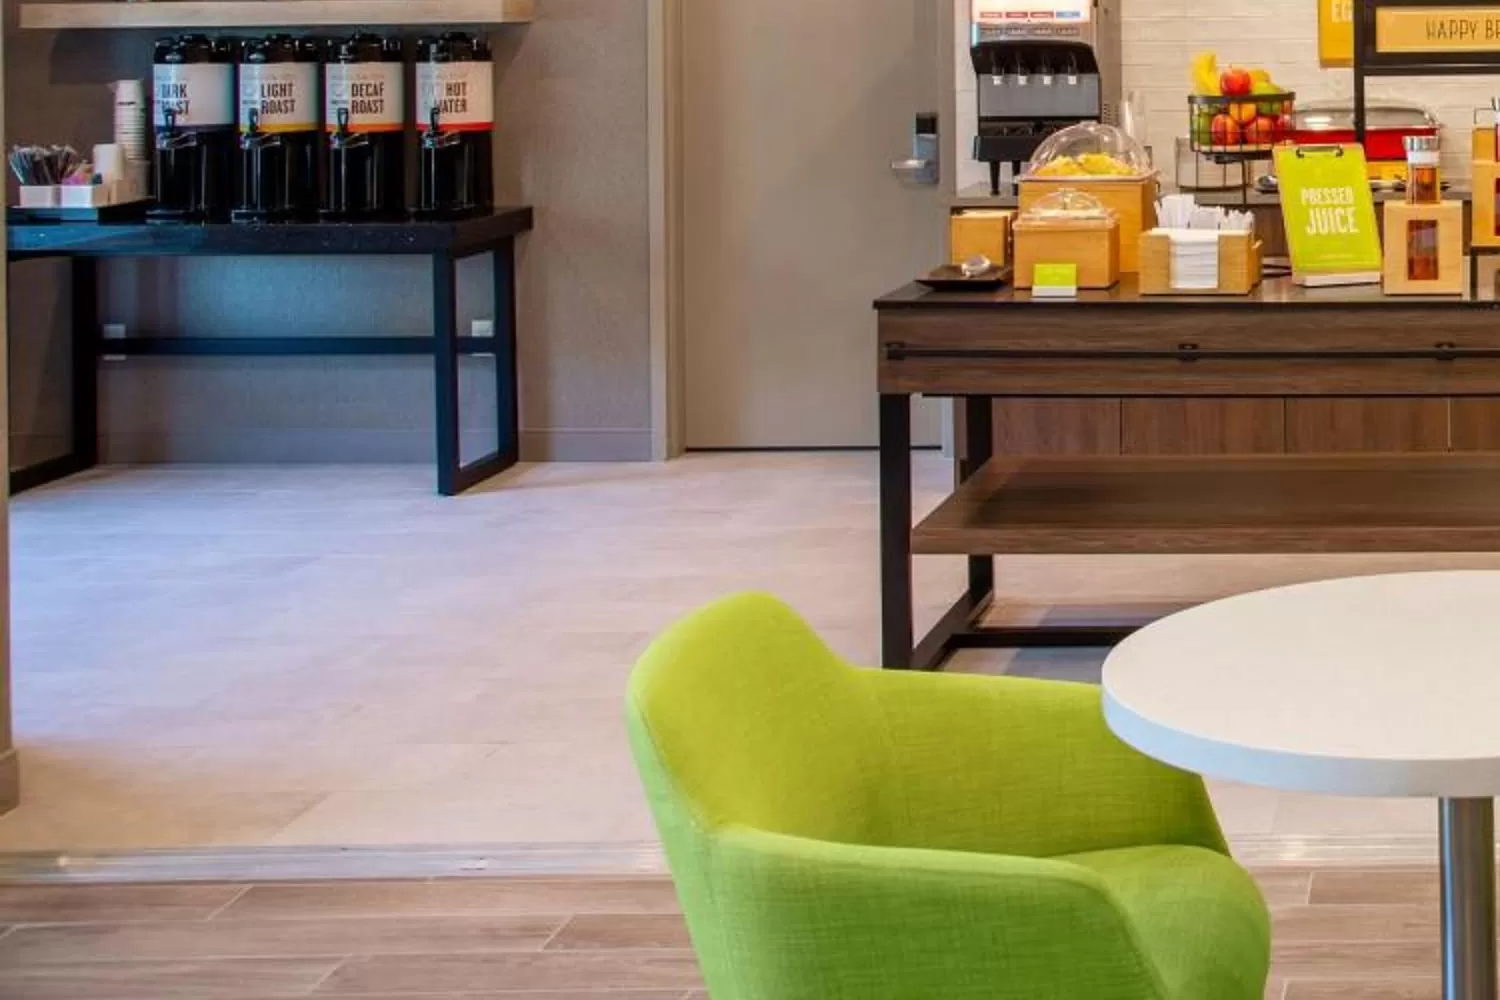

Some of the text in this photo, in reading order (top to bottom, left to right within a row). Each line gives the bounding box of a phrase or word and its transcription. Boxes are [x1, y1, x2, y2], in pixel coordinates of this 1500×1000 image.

[1425, 19, 1477, 40] HAPPY
[261, 83, 294, 98] LIGHT
[351, 83, 384, 97] DECAF
[445, 82, 467, 96] HOT
[261, 100, 296, 114] ROAST
[351, 100, 385, 114] ROAST
[1301, 187, 1354, 206] PRESSED
[1307, 207, 1358, 234] JUICE
